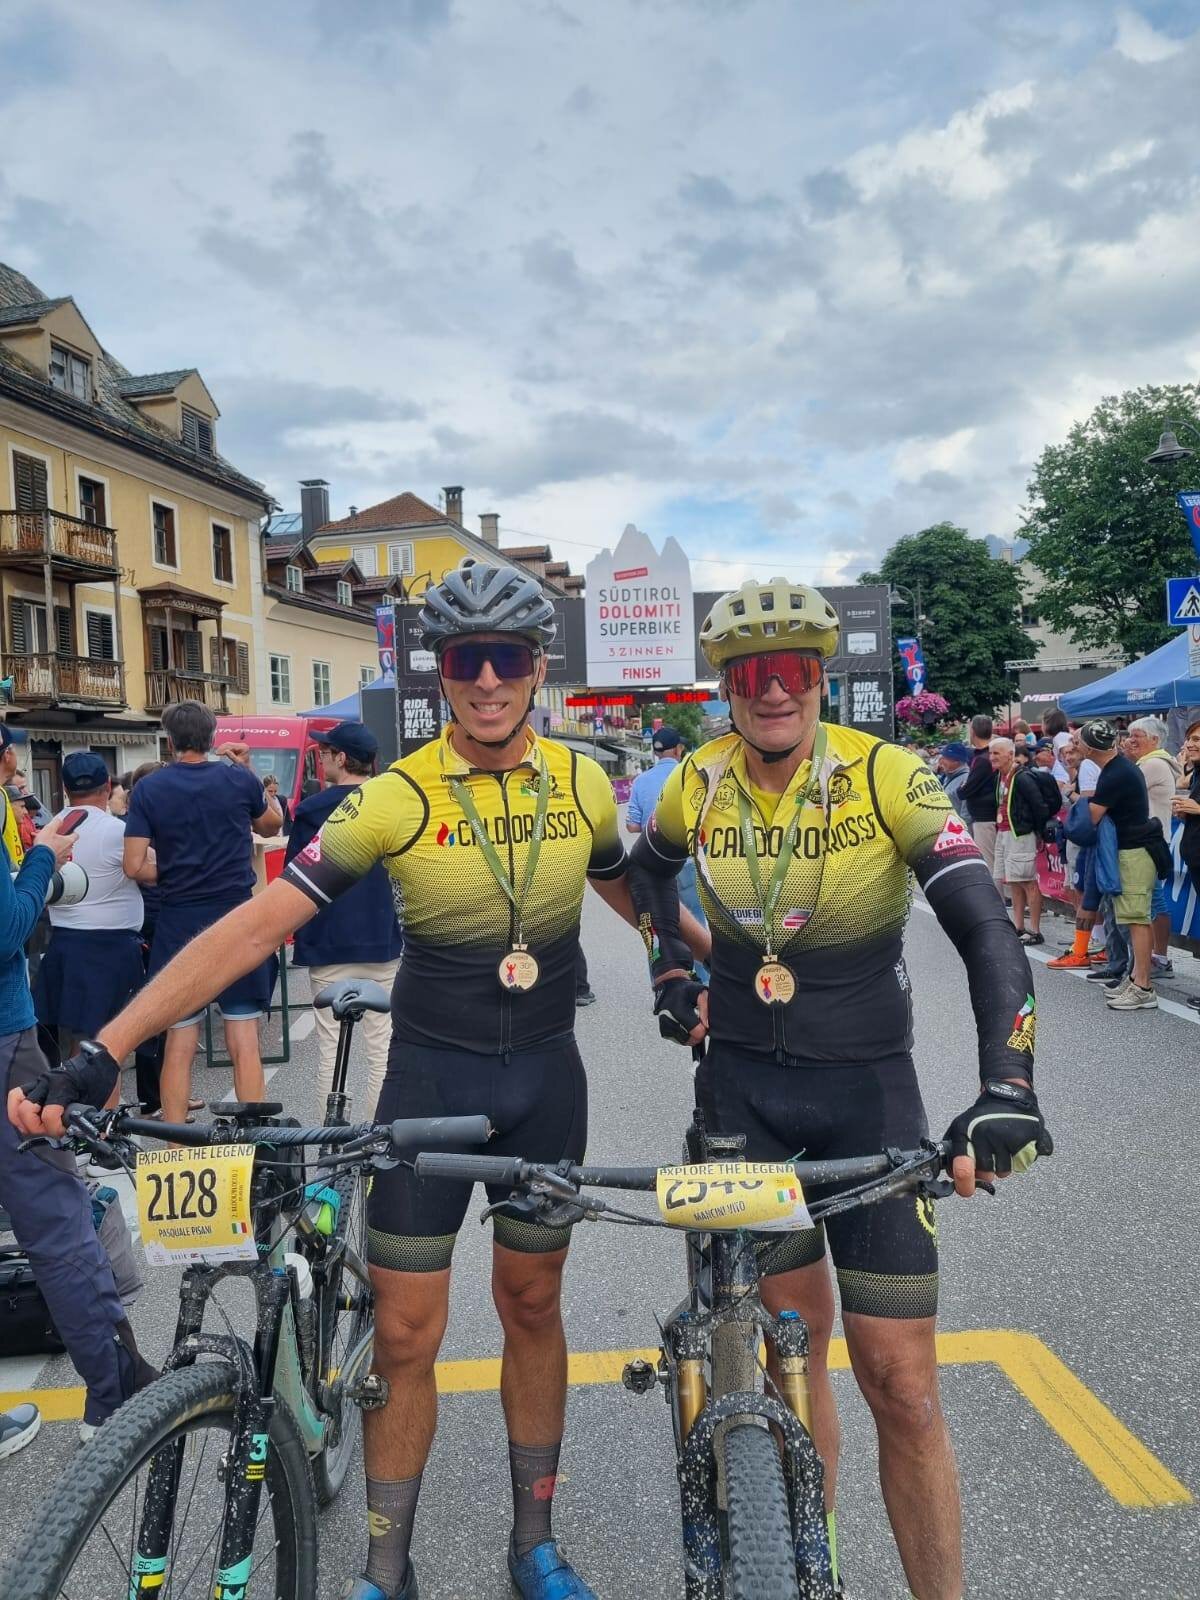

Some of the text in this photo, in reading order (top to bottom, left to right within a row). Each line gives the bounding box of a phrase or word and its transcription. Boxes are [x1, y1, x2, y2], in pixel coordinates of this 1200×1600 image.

[599, 586, 680, 602] SÜDTIROL
[600, 604, 680, 619] DOLOMITI
[600, 621, 680, 636] SUPERBIKE
[622, 667, 661, 680] FINISH
[853, 682, 879, 692] RIDE
[853, 691, 883, 702] WITH
[403, 699, 429, 709] RIDE
[853, 701, 887, 712] NATU-
[404, 709, 433, 718] WITH
[404, 718, 437, 728] NATU-
[138, 1145, 254, 1165] EXPLORE THE LEGEND
[660, 1164, 794, 1176] EXPLORE THE LEGEND
[146, 1168, 218, 1221] 2128
[694, 1201, 746, 1221] MANCINI VITO
[158, 1225, 213, 1238] PASQUALE PISANI
